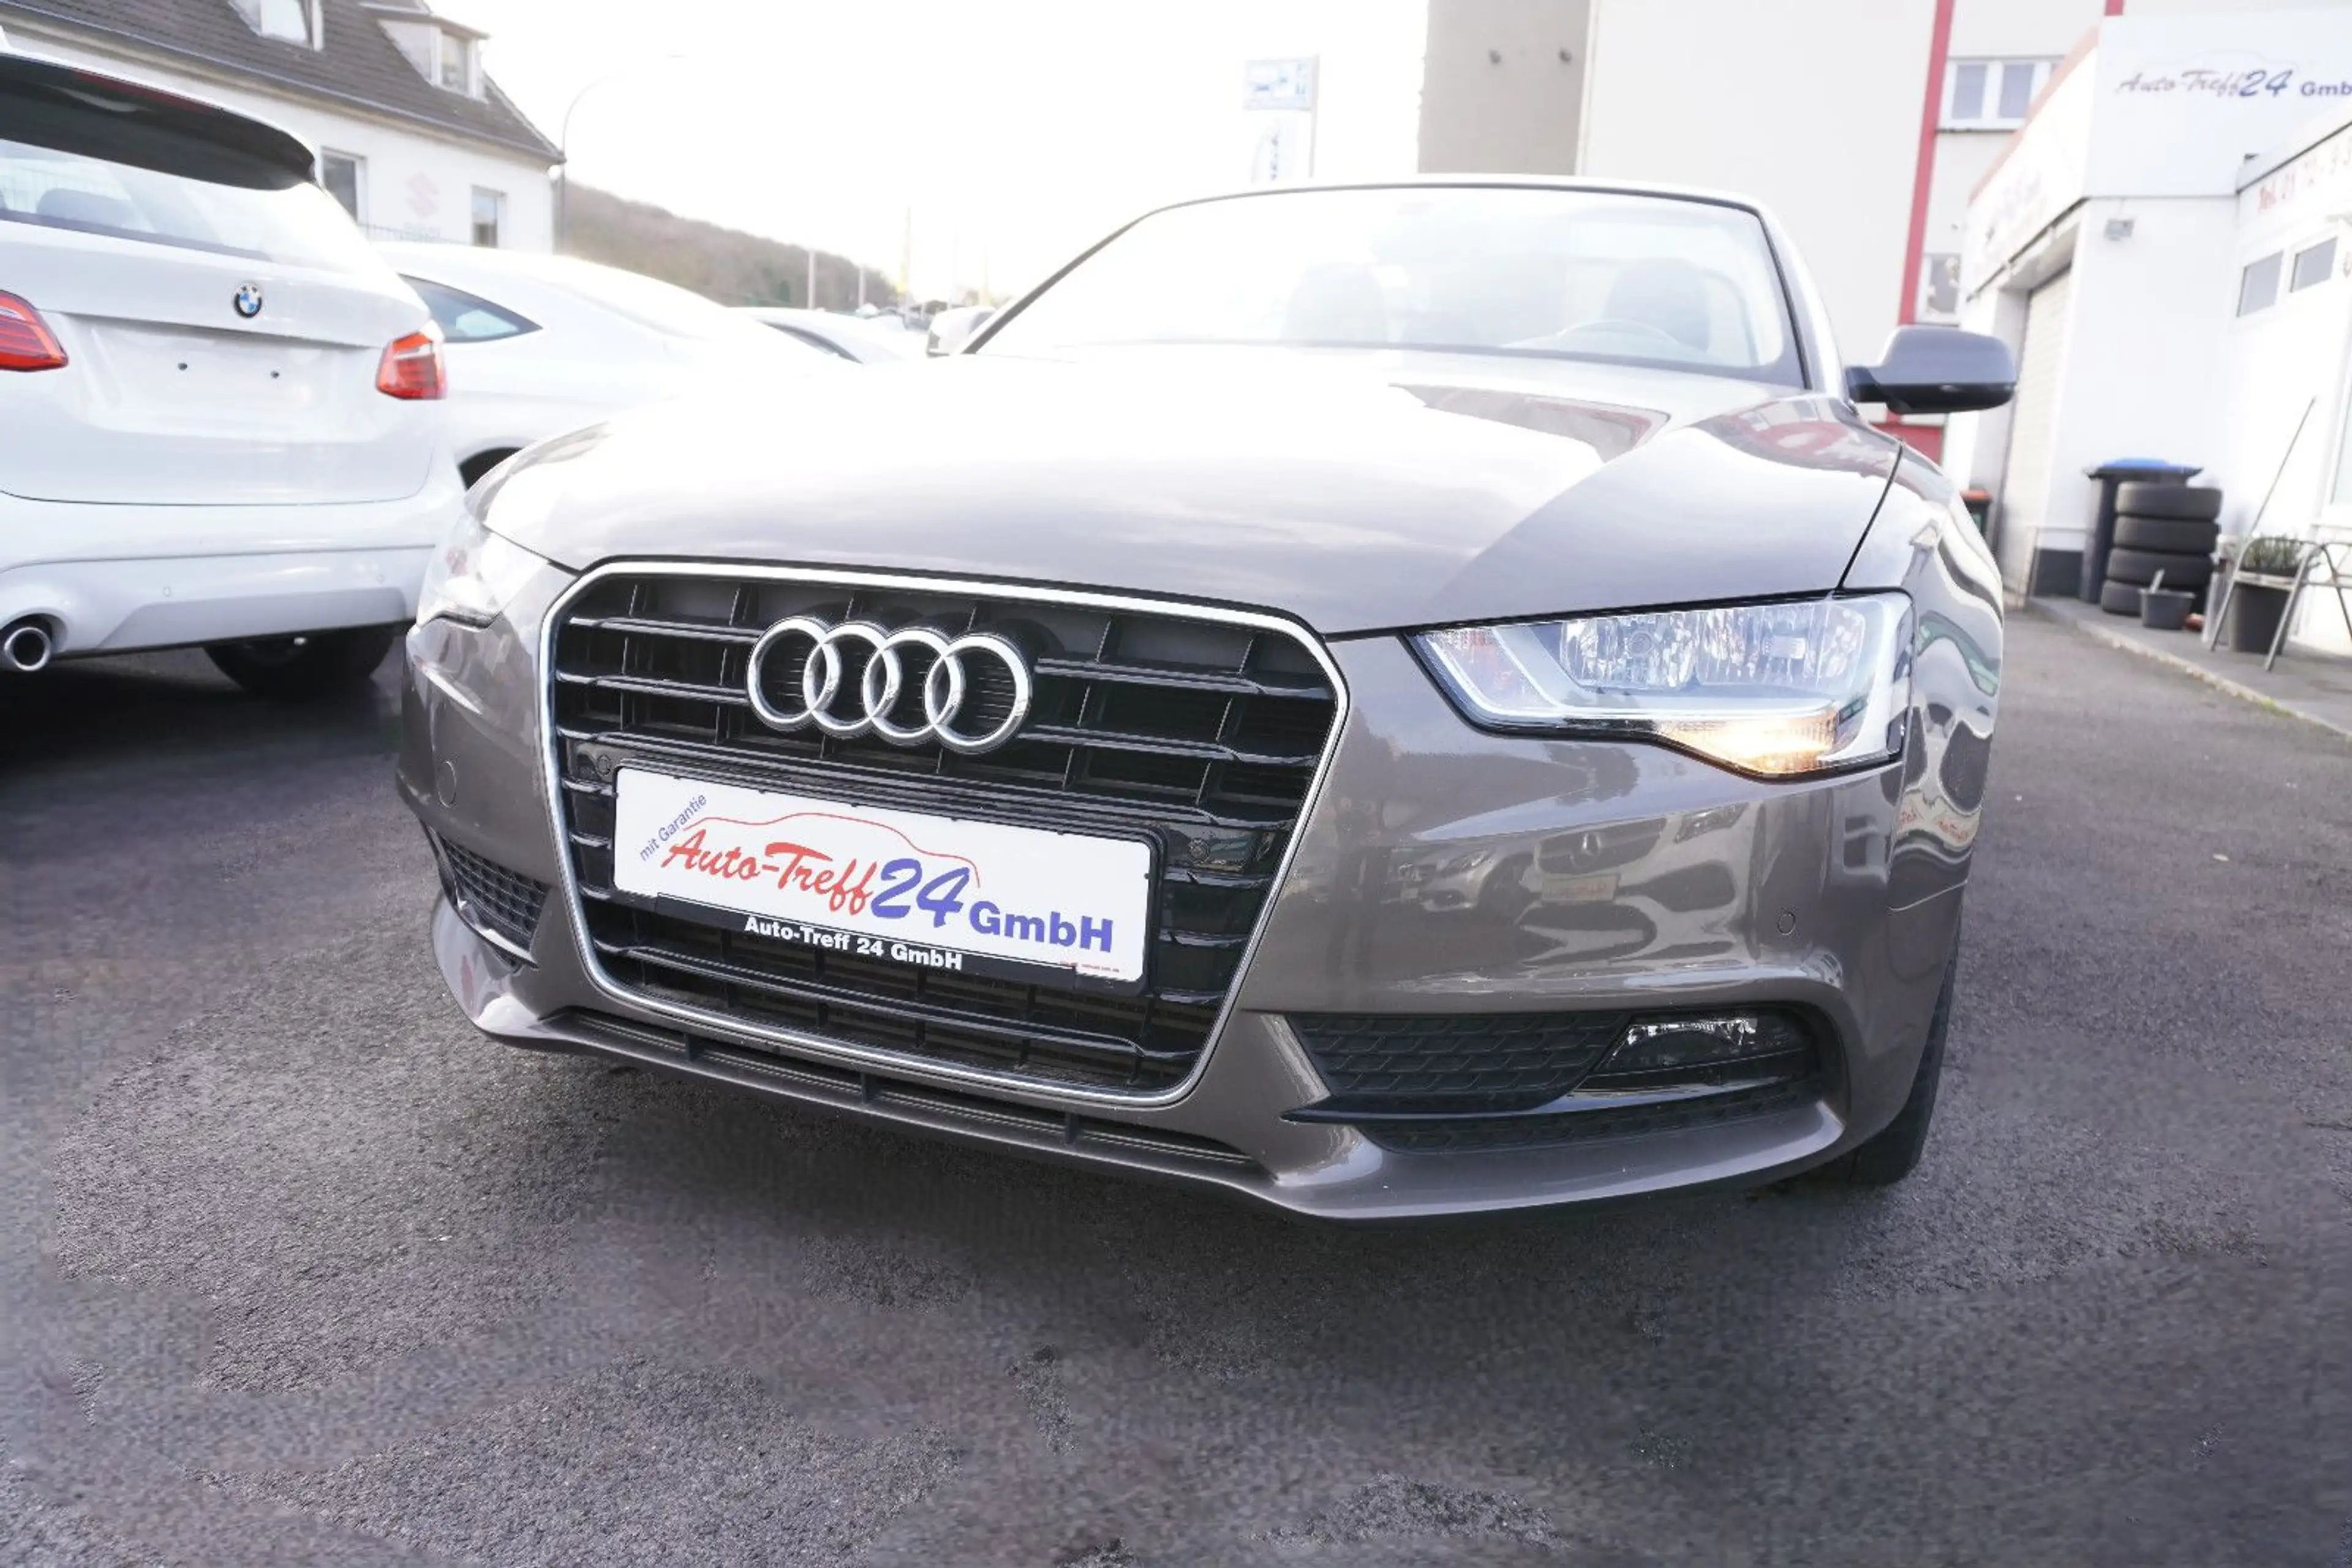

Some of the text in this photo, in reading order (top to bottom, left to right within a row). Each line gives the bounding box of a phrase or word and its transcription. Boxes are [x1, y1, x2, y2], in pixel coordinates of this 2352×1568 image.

[639, 794, 707, 861] mit Garantie
[744, 917, 963, 971] Auto-Treff 24 GmbH
[969, 900, 1114, 953] GmbH
